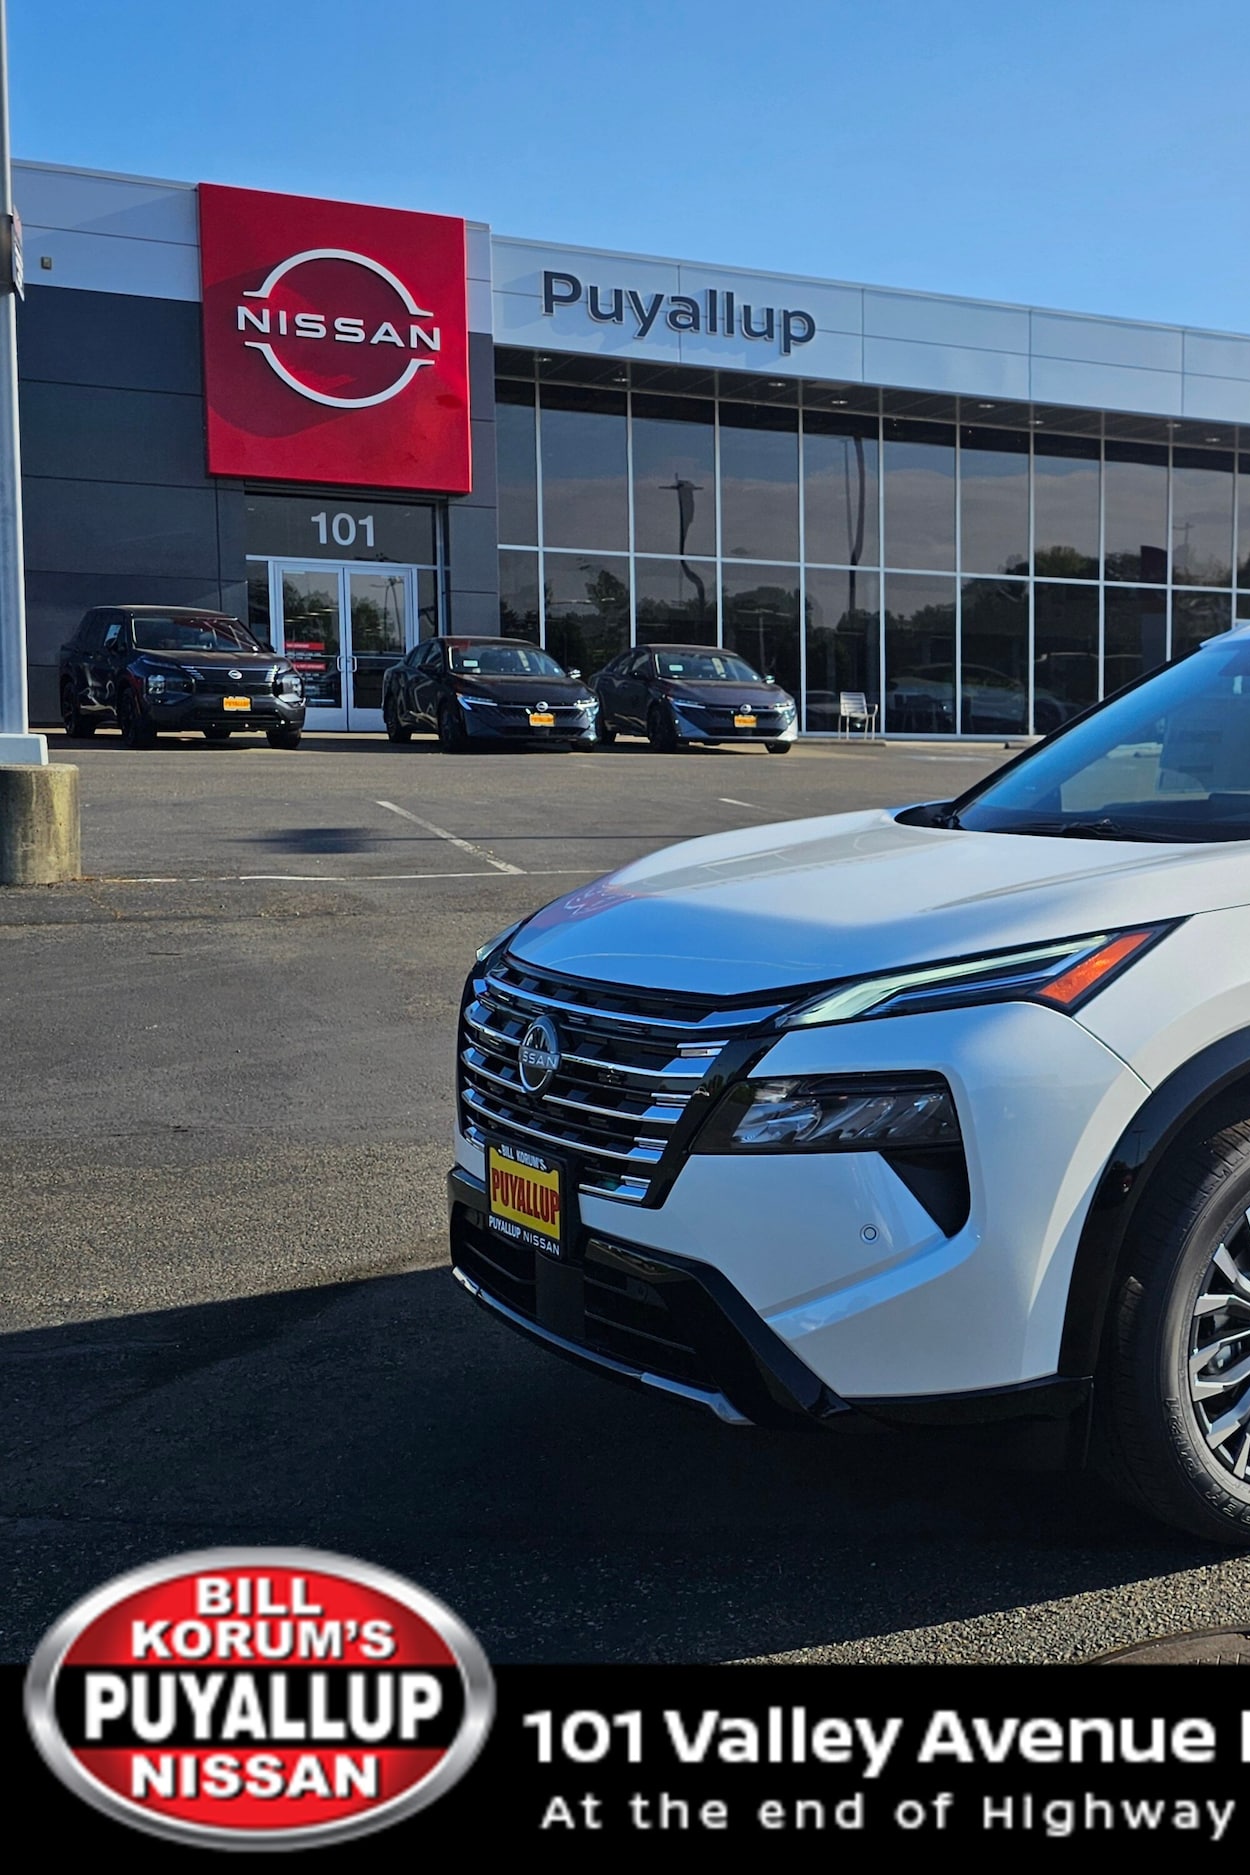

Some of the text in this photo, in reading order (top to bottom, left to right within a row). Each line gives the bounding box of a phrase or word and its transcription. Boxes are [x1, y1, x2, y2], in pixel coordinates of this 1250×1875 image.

[236, 305, 441, 352] NISSAN
[542, 270, 817, 355] Puyallup
[310, 512, 375, 547] 101
[491, 1167, 560, 1225] PUYALLUP
[488, 1214, 560, 1256] PUYALLUP NISSAN
